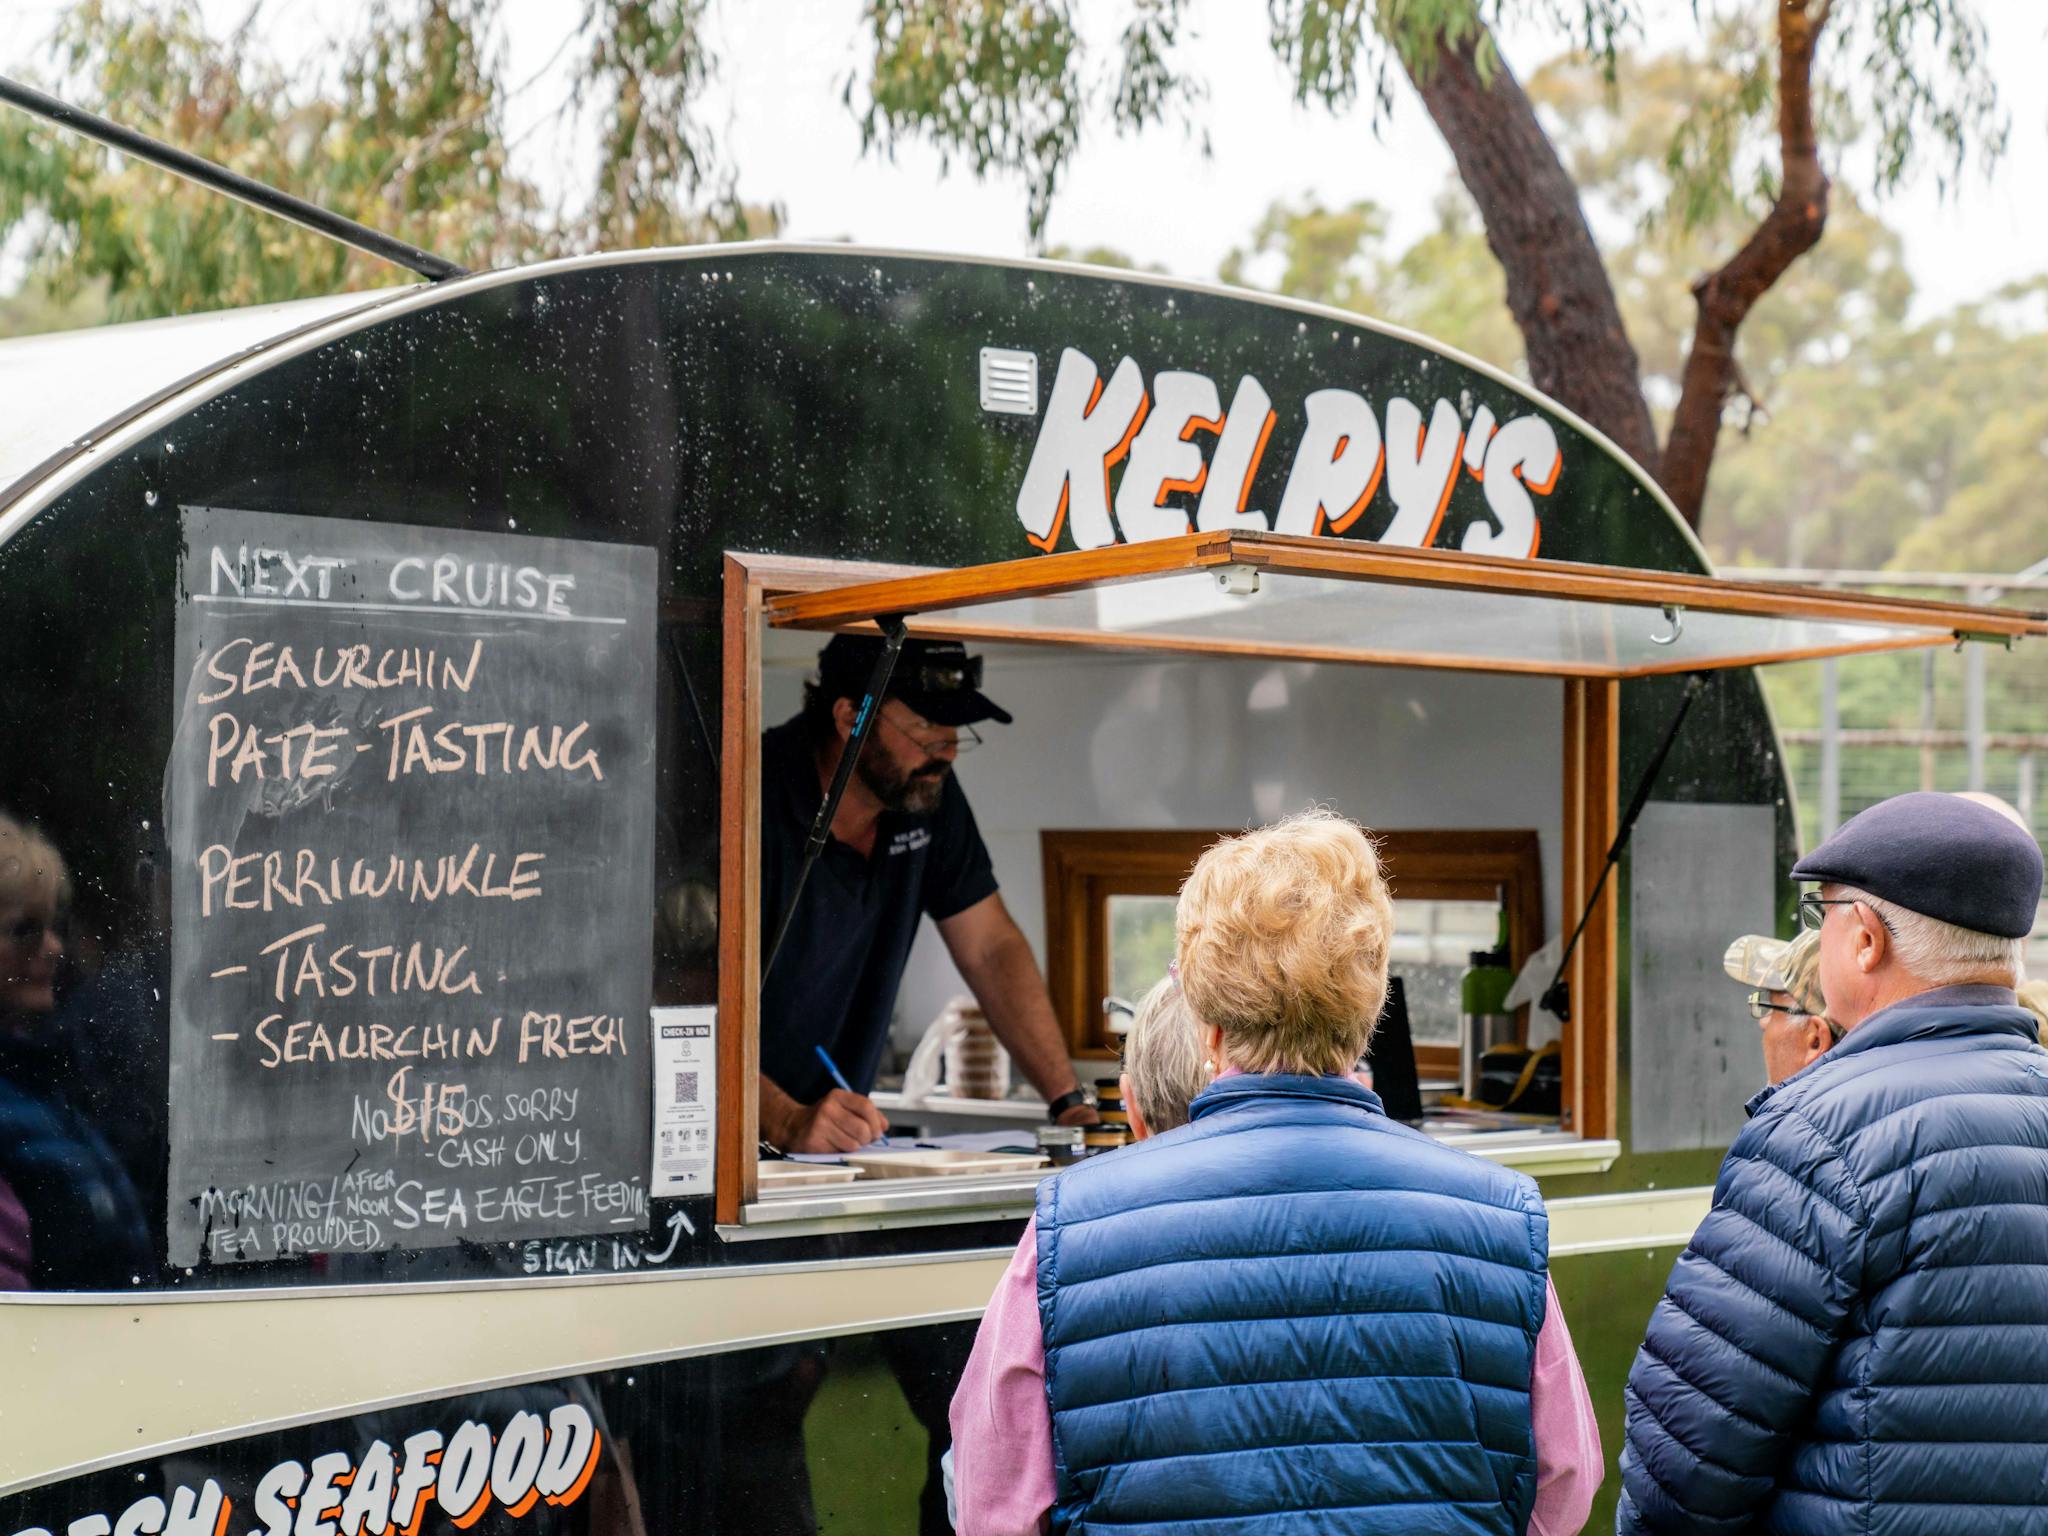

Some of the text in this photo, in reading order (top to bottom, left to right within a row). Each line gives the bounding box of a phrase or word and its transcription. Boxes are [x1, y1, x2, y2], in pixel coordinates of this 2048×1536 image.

[1016, 347, 1561, 559] KELPY'S
[210, 540, 576, 616] NEXT CRUISE
[200, 843, 545, 917] PERRIWINKLE
[519, 1010, 628, 1063] FRESH
[384, 1065, 466, 1145] $15
[210, 1226, 261, 1257] TEA
[394, 1180, 467, 1229] SEA
[523, 1241, 640, 1275] SIGN IN
[247, 1403, 600, 1536] SEAFOOD
